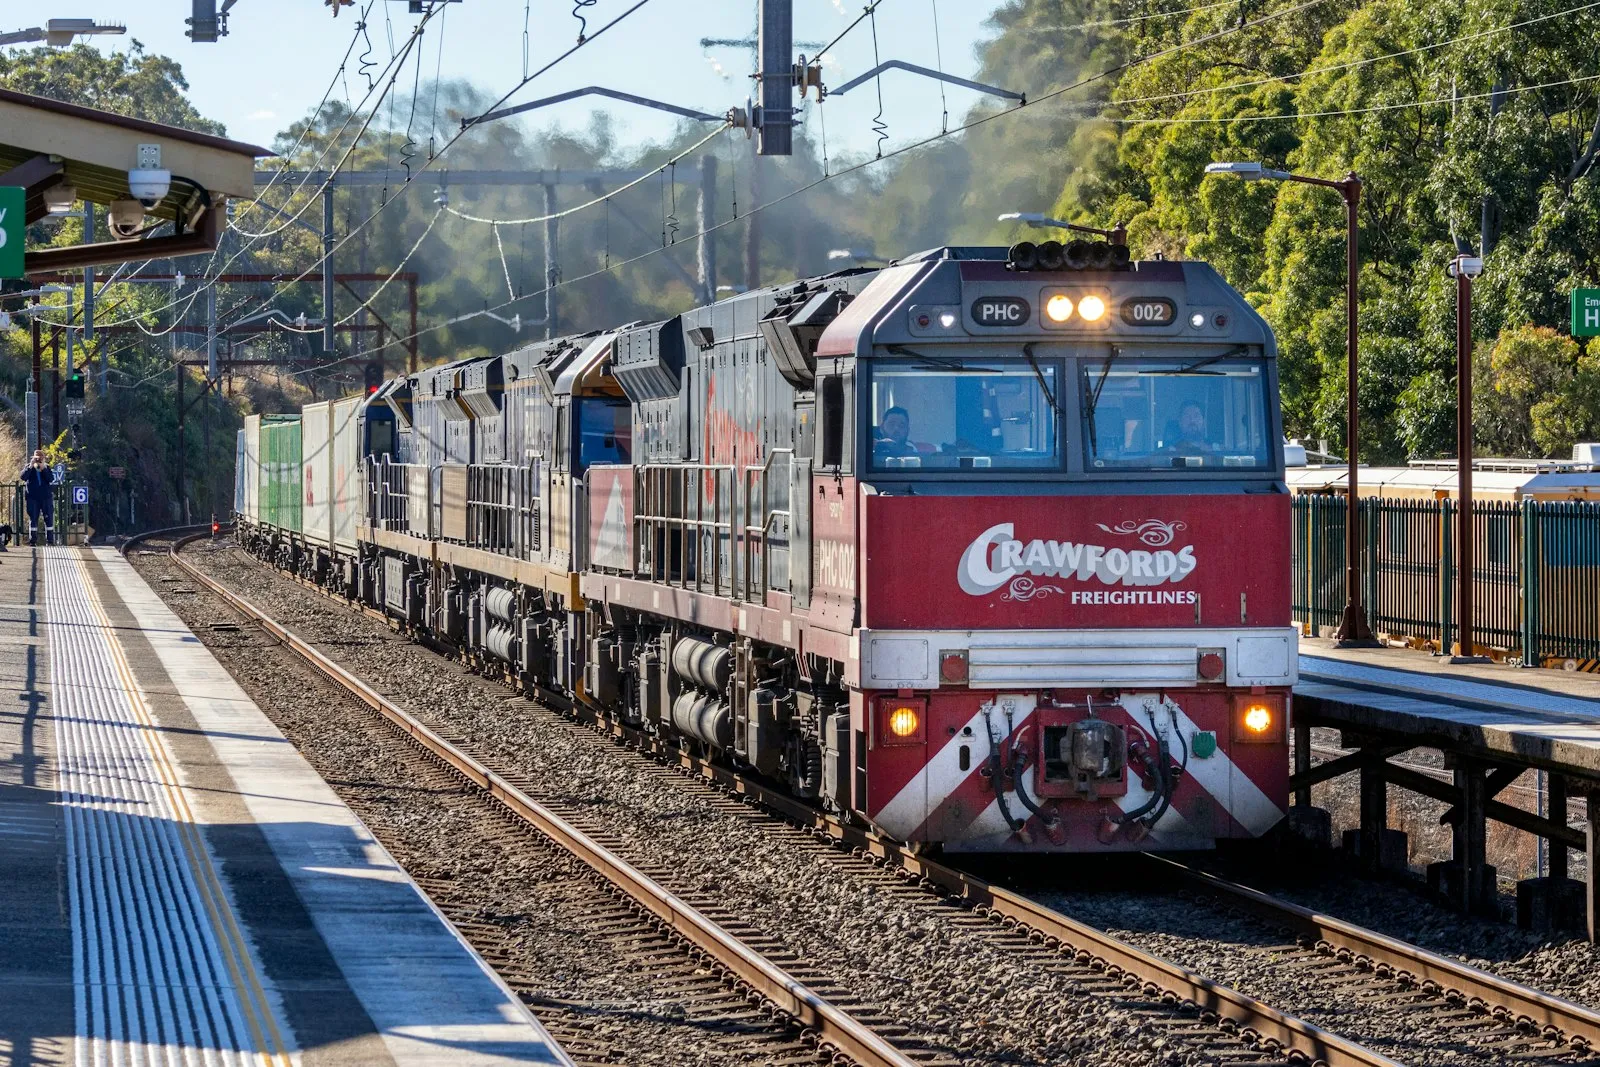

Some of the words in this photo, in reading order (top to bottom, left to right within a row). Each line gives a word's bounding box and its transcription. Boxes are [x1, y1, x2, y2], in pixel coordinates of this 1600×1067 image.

[982, 304, 1020, 321] PHC
[1133, 304, 1164, 321] 002
[76, 488, 86, 502] 6
[820, 539, 838, 587] PHC
[839, 542, 855, 590] 002
[957, 522, 1197, 596] CRAWFORDS
[1071, 590, 1196, 605] FREIGHTLINES
